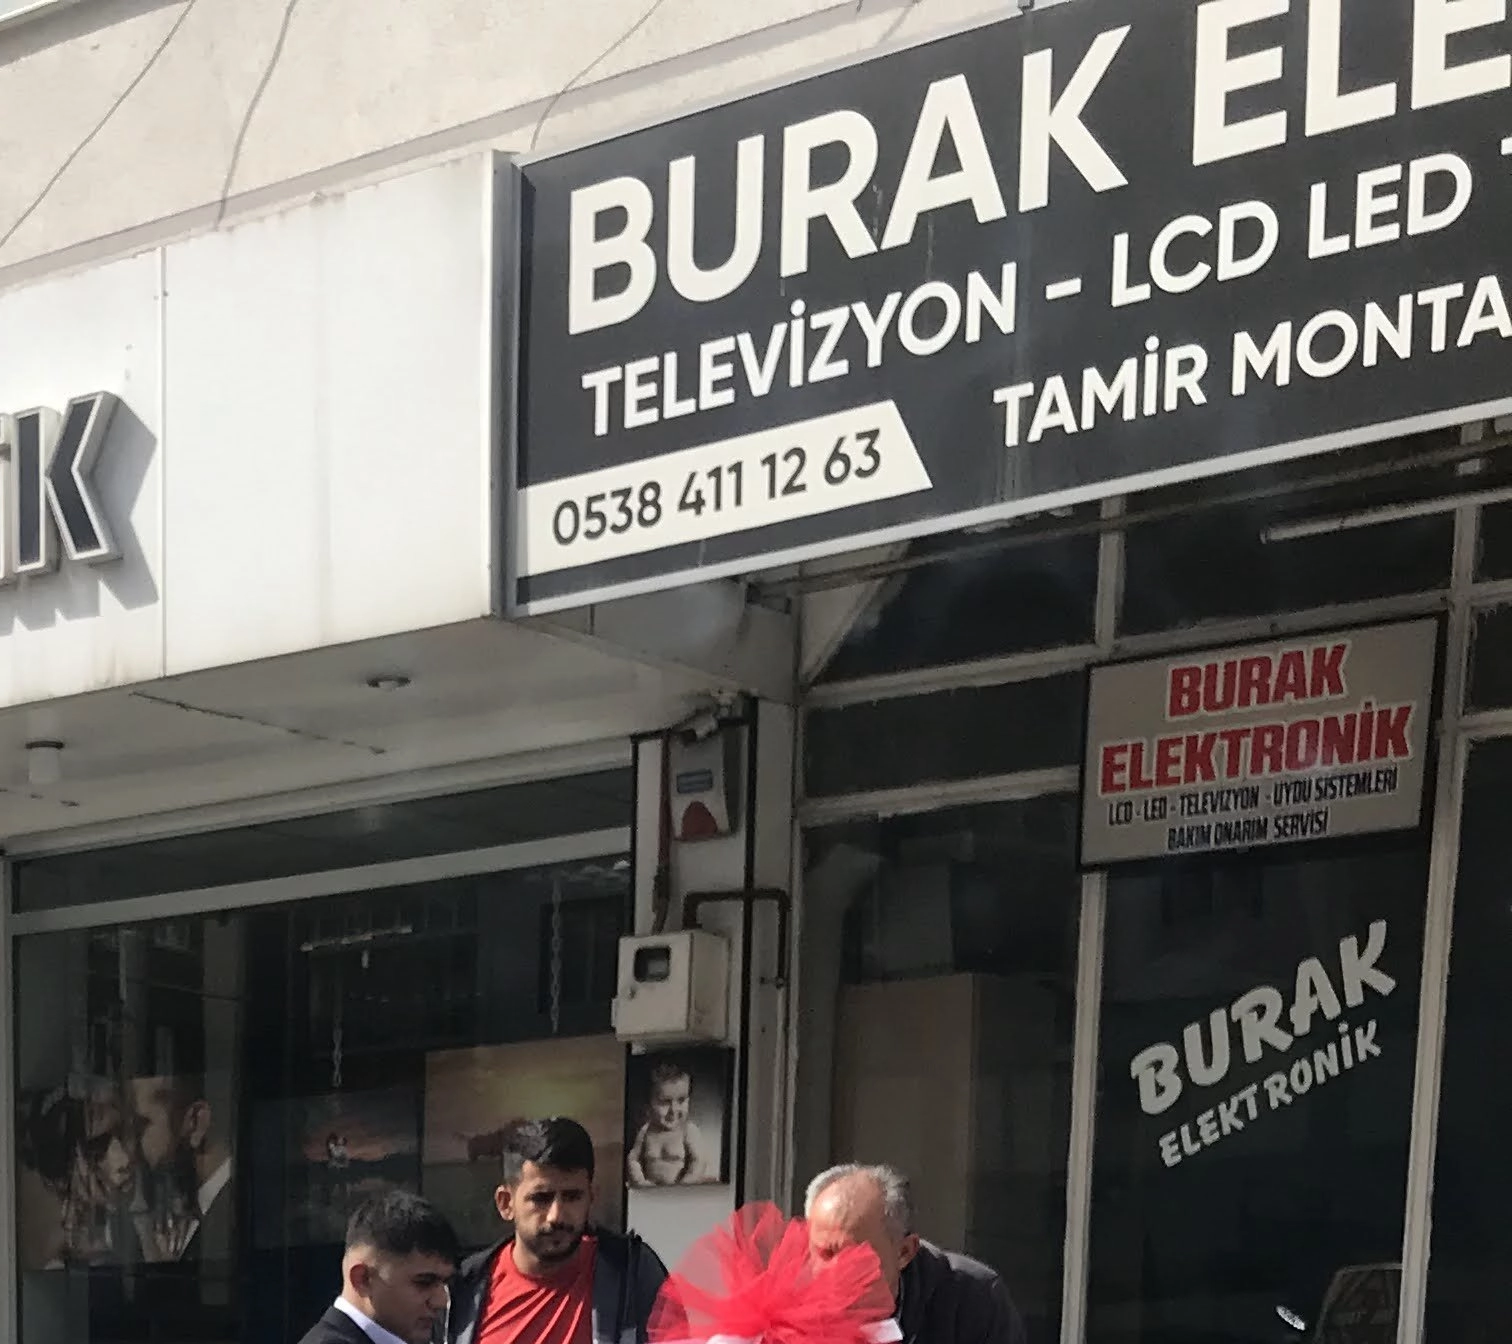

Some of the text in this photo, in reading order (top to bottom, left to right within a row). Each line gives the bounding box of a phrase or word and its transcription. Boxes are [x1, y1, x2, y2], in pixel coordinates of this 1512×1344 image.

[568, 0, 1512, 335] BURAK ELE
[582, 260, 1018, 437] TELEVİZYON
[1111, 200, 1280, 308] LCD
[1308, 152, 1473, 260] LED
[993, 275, 1512, 448] TAMİR MONTA
[551, 428, 883, 547] 0538 411 12 63
[1168, 642, 1349, 718] BURAK
[1100, 699, 1415, 797] ELEKTRONİK
[1108, 801, 1133, 826] LCD
[1143, 796, 1168, 822] LED
[1273, 778, 1312, 807] UYDU
[1214, 816, 1269, 846] ONARIM
[1129, 919, 1399, 1117] BURAK
